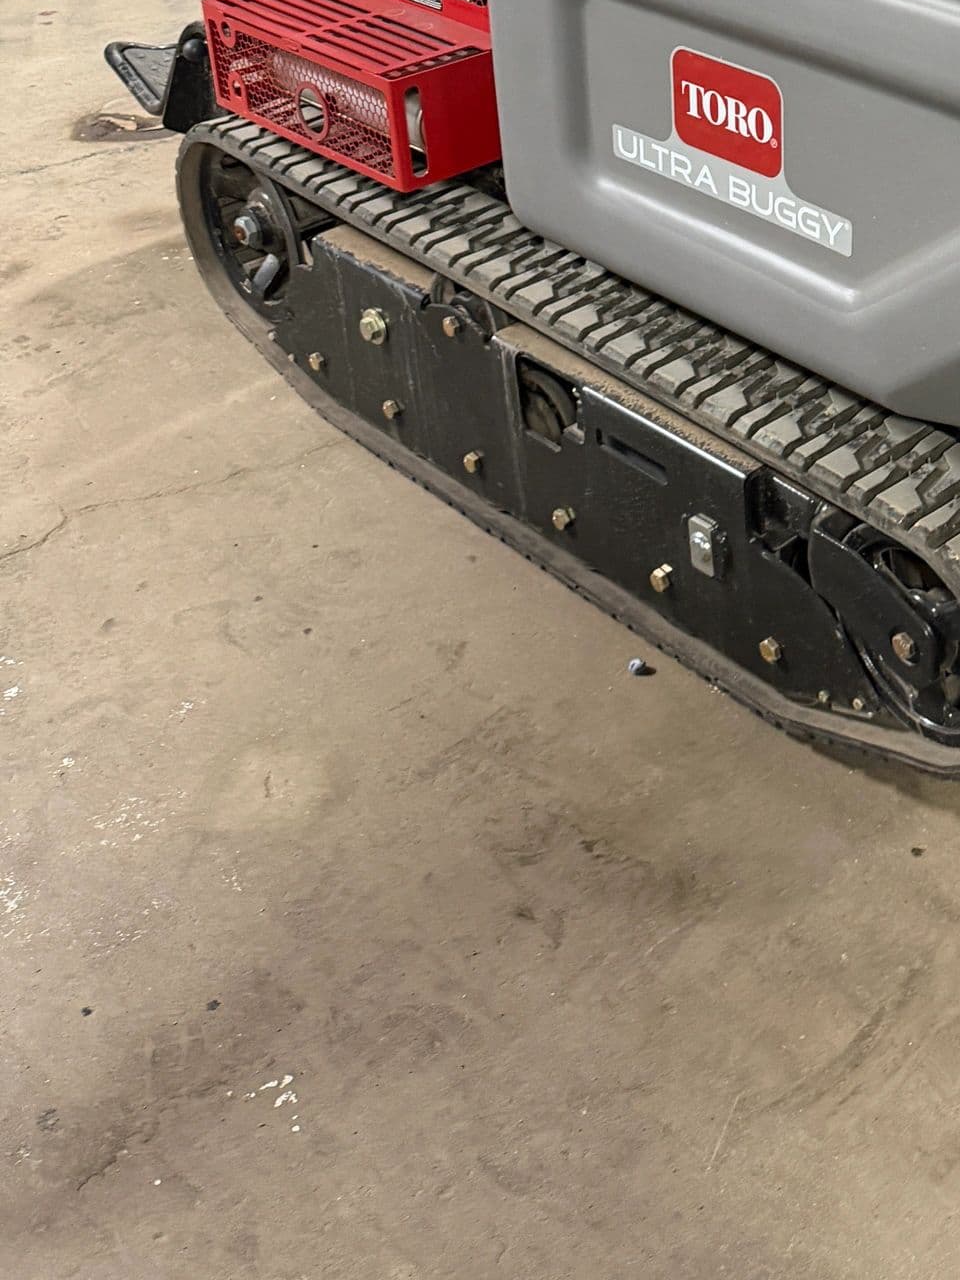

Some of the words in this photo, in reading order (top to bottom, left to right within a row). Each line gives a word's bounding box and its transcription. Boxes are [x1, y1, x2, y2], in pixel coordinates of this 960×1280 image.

[681, 79, 774, 144] TORO
[616, 130, 718, 195] ULTRA
[728, 174, 845, 246] BUGGY
